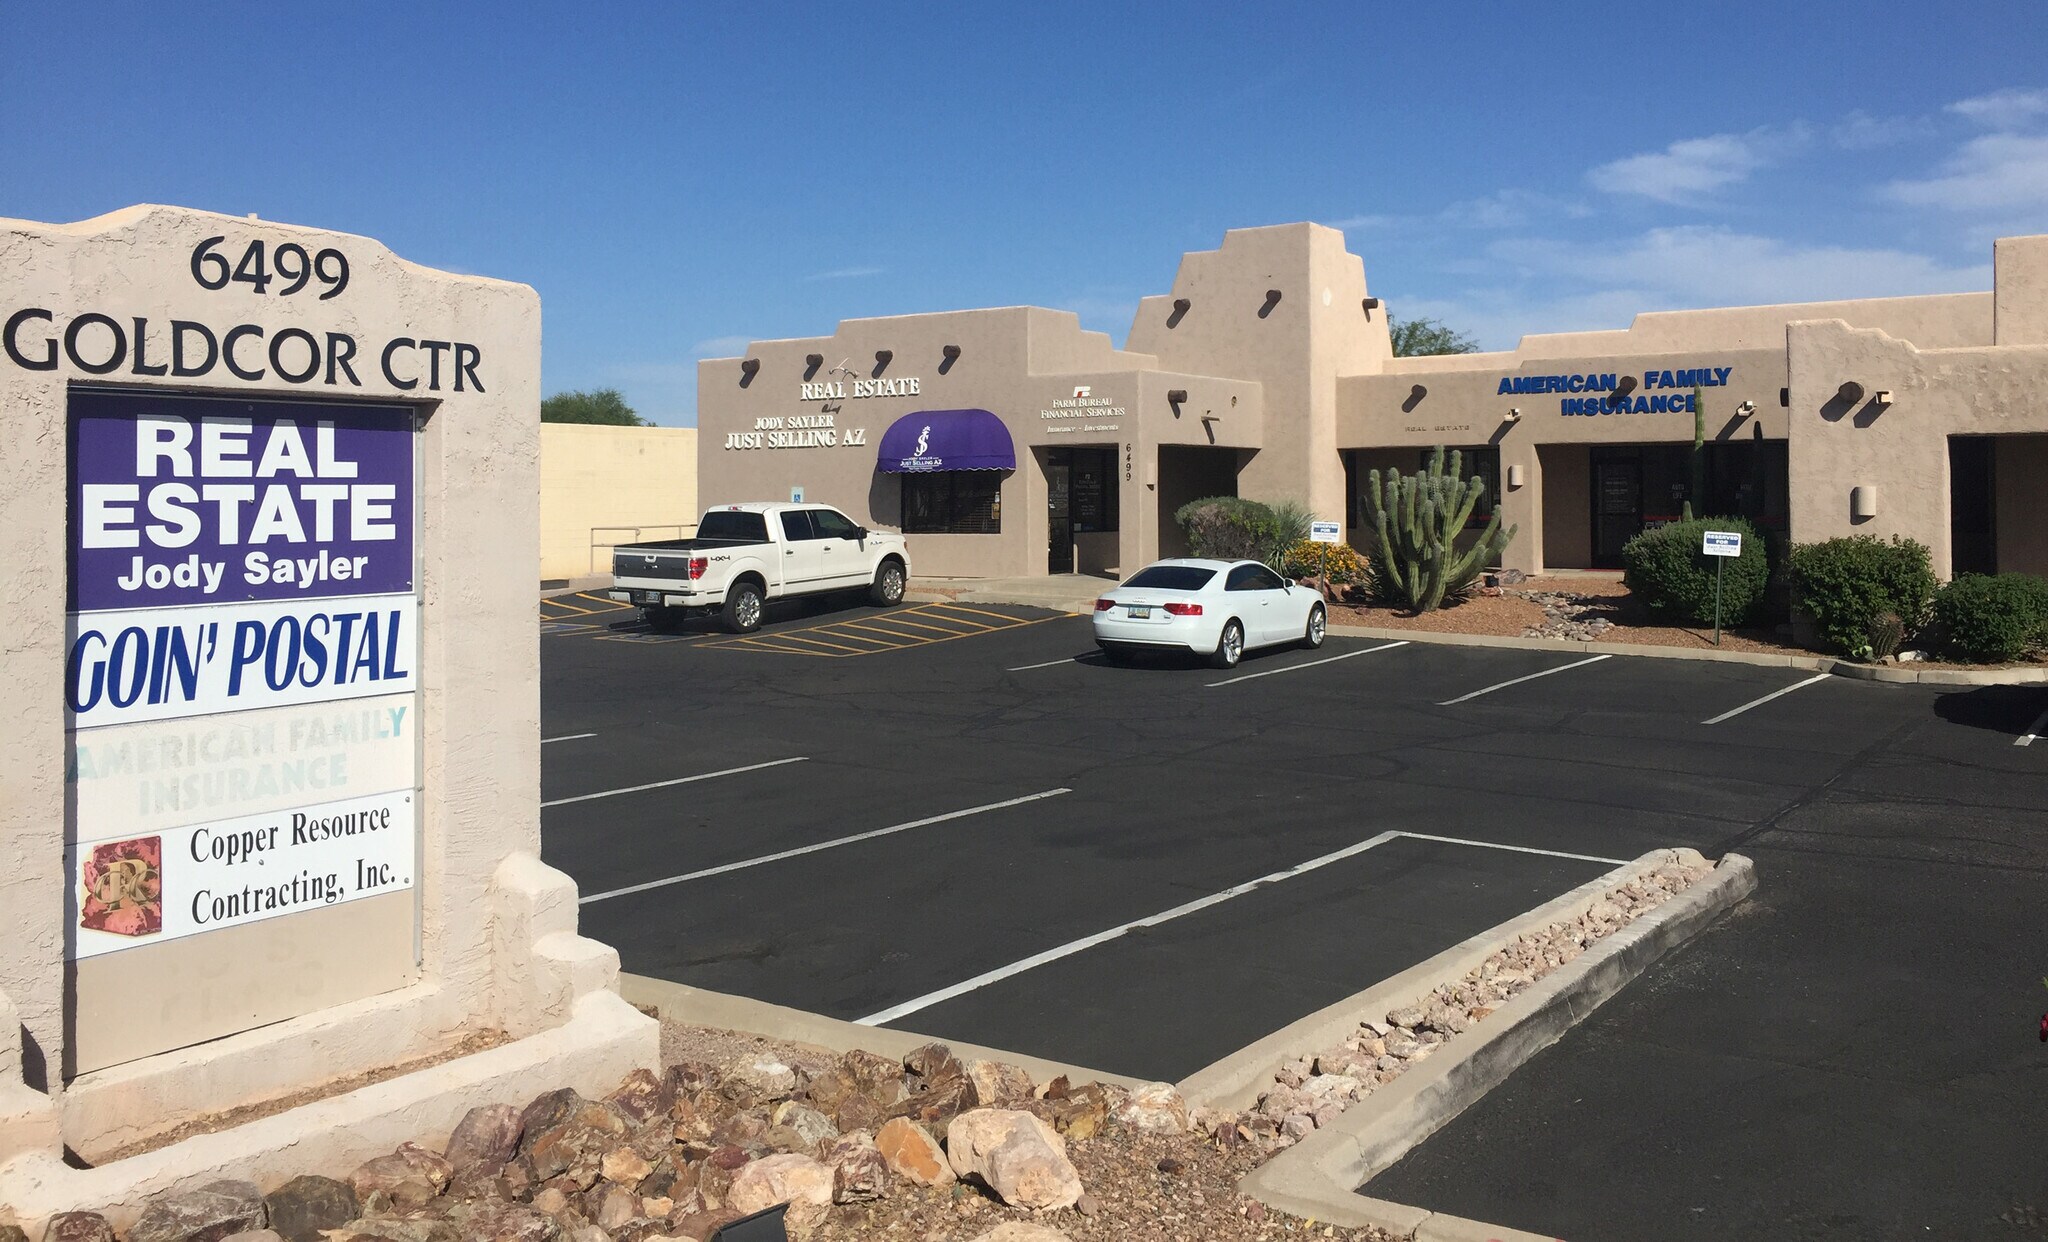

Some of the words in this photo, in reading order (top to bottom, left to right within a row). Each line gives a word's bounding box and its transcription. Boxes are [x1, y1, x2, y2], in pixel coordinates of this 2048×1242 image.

[191, 236, 349, 300] 6499
[2, 308, 361, 386] GOLDCOR
[381, 338, 485, 393] CTR
[1497, 373, 1617, 395] AMERICAN
[1644, 367, 1733, 389] FAMILY
[801, 382, 847, 401] REAL
[853, 377, 920, 399] ESTATE
[1041, 409, 1085, 419] FINANCIAL
[1086, 407, 1125, 418] SERVICES
[1052, 399, 1076, 408] FARM
[1078, 397, 1112, 407] BUREAU
[136, 413, 358, 478] REAL
[725, 432, 764, 450] JUST
[768, 430, 838, 449] SELLING
[842, 428, 867, 448] AZ
[755, 416, 785, 430] JODY
[788, 414, 835, 430] SAYLER
[82, 483, 396, 549] ESTATE
[118, 555, 225, 593] Jody
[244, 551, 368, 589] Sayler
[66, 622, 217, 713] GOIN'
[228, 610, 409, 697] POSTAL
[66, 722, 275, 784] AMERICAN
[290, 706, 408, 752] FAMILY
[140, 753, 348, 816] INSURANCE
[190, 821, 279, 866] Copper
[291, 806, 390, 845] Resource
[192, 868, 345, 924] Contracting,
[356, 857, 396, 891] Inc.
